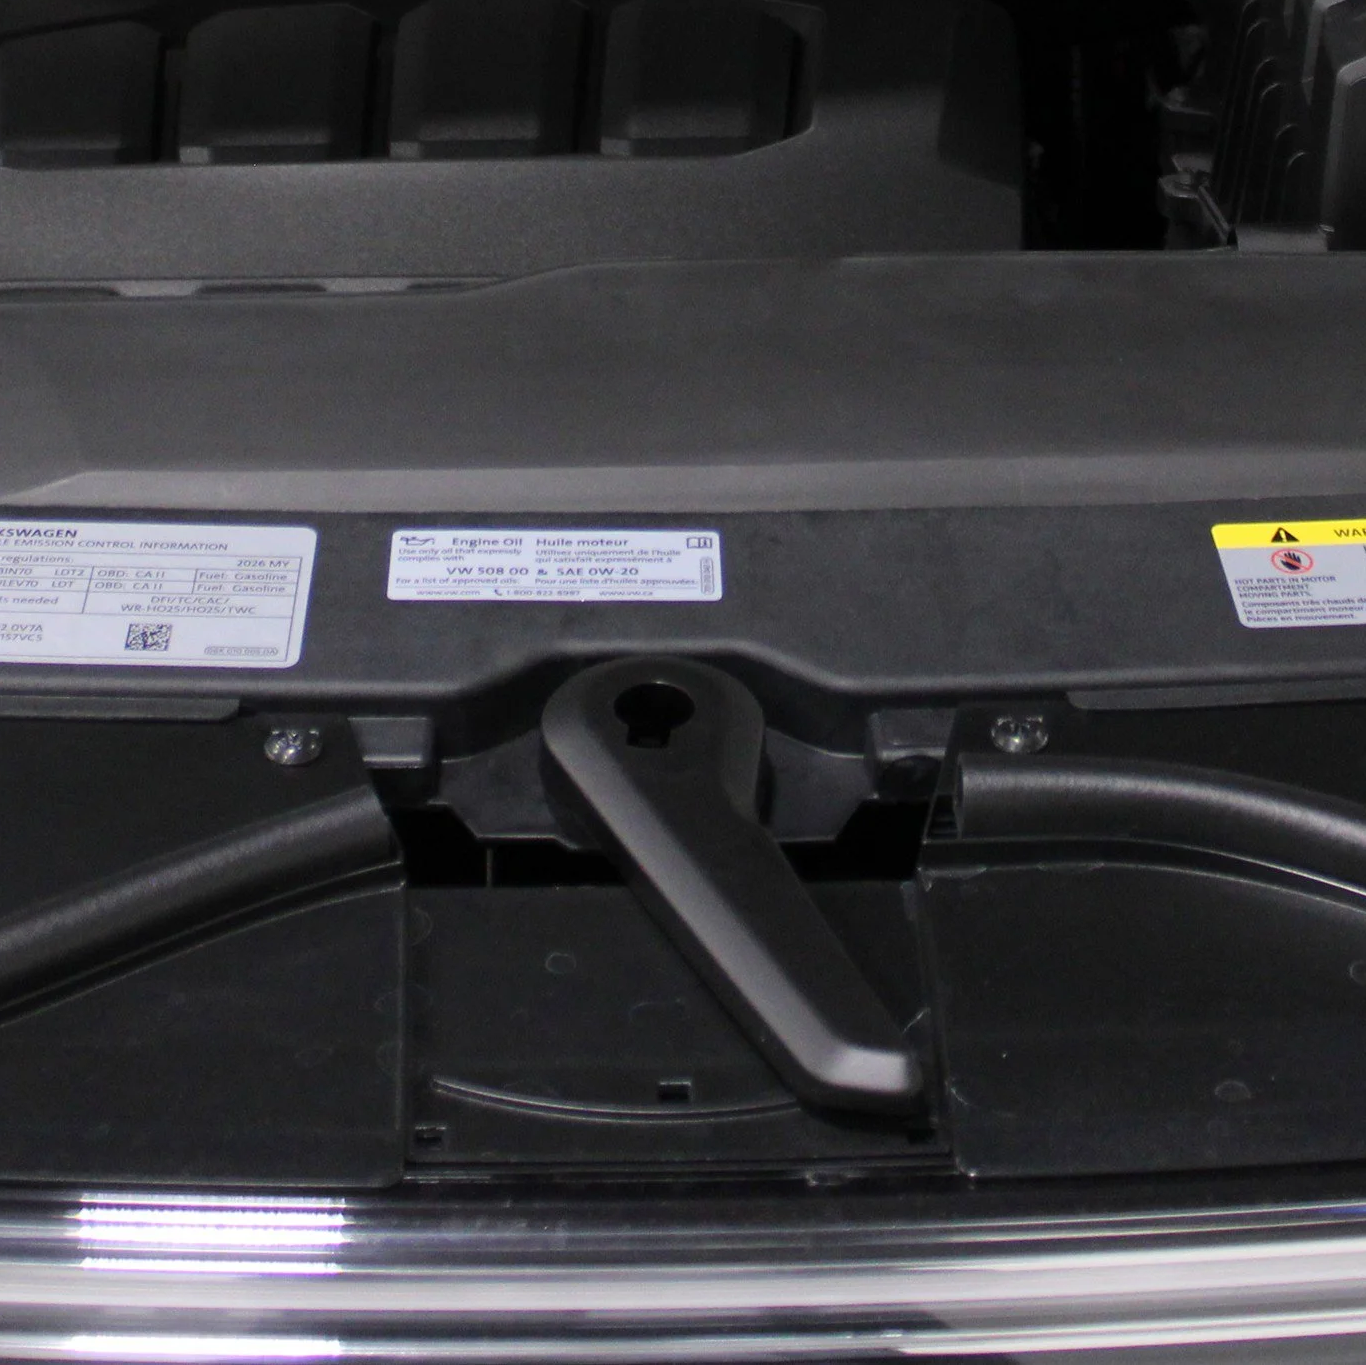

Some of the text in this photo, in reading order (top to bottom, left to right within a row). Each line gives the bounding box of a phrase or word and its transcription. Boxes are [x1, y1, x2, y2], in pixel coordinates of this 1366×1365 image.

[77, 540, 135, 549] CONTROL
[140, 541, 228, 551] INFORMATION
[452, 538, 523, 548] Engine Oil
[536, 538, 629, 547] Huile moteur
[418, 548, 438, 556] only
[477, 548, 522, 556] expressly
[574, 549, 634, 557] uniquement
[398, 555, 440, 563] complies
[236, 560, 289, 568] 2026 MY
[54, 569, 85, 577] LDT2
[447, 567, 473, 575] VW
[478, 567, 504, 576] 508
[509, 567, 529, 576] 00
[557, 568, 586, 576] SAE
[589, 568, 639, 576] 0W-20
[235, 572, 287, 581] Gasoline
[452, 577, 498, 586] approved
[232, 584, 286, 593] Gasoline
[1236, 584, 1309, 592] COMPARTMENT
[12, 596, 58, 605] needed
[1242, 600, 1300, 608] Composants
